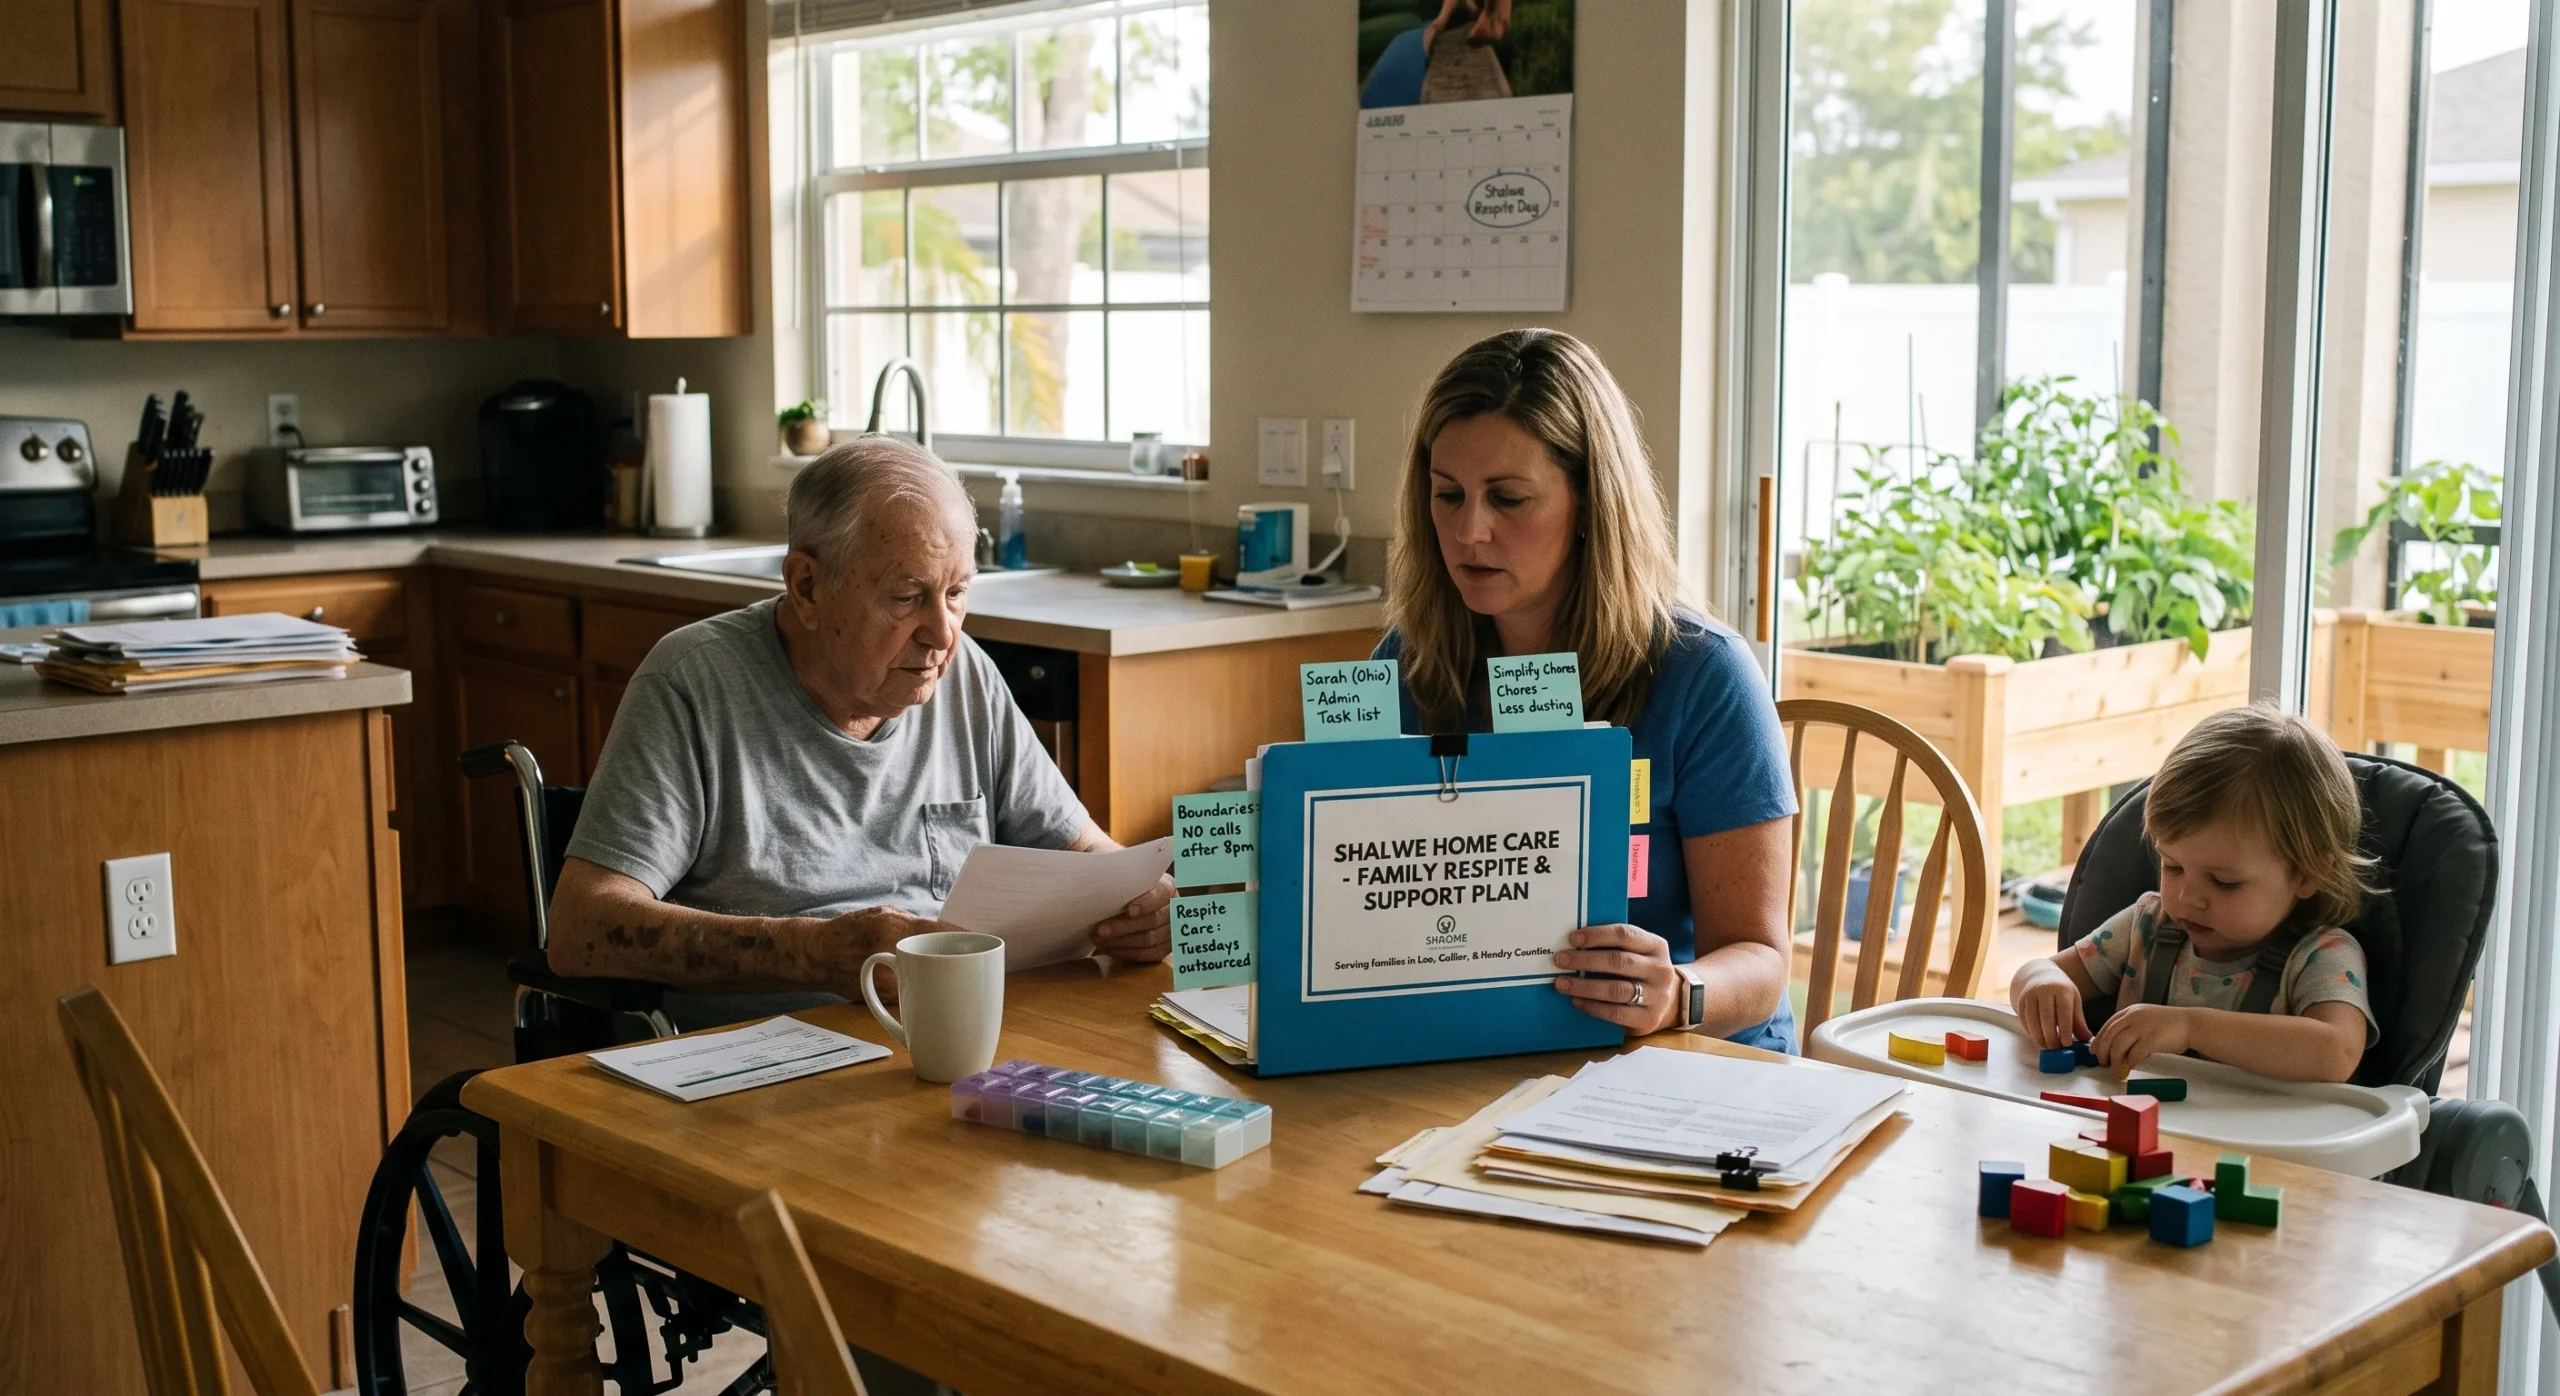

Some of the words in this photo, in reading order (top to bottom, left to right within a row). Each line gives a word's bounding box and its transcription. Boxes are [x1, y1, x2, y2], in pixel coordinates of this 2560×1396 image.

[1518, 199, 1539, 218] Day
[1306, 670, 1347, 686] Sarah
[1352, 664, 1391, 685] (Ohio)
[1494, 662, 1540, 681] Simplify
[1543, 661, 1576, 675] Chores
[1318, 691, 1360, 705] Admin
[1497, 684, 1538, 697] Chores
[1317, 709, 1352, 724] Task
[1357, 707, 1381, 722] list
[1499, 702, 1525, 715] Less
[1529, 699, 1573, 716] dusting
[1178, 802, 1260, 819] Boundaries:
[1182, 825, 1203, 839] NO
[1210, 822, 1241, 837] calls
[1181, 843, 1219, 858] after
[1224, 840, 1254, 857] 8pm
[1334, 839, 1427, 863] SHALWE
[1433, 834, 1497, 857] HOME
[1503, 830, 1560, 851] CARE
[1357, 863, 1438, 886] FAMILY
[1444, 856, 1528, 881] RESPITE
[1533, 855, 1552, 875] &
[1364, 886, 1466, 911] SUPPORT
[1472, 881, 1529, 904] PLAN
[1176, 901, 1226, 920] Respite
[1178, 939, 1240, 956] Tuesdays
[1425, 933, 1468, 945] SHAOME
[1179, 953, 1251, 974] outsourced
[1335, 960, 1369, 970] Serving
[1371, 957, 1406, 967] families
[1408, 956, 1416, 965] in
[1472, 952, 1479, 960] &
[1481, 949, 1512, 959] Hendry
[1514, 947, 1554, 957] Counties.
